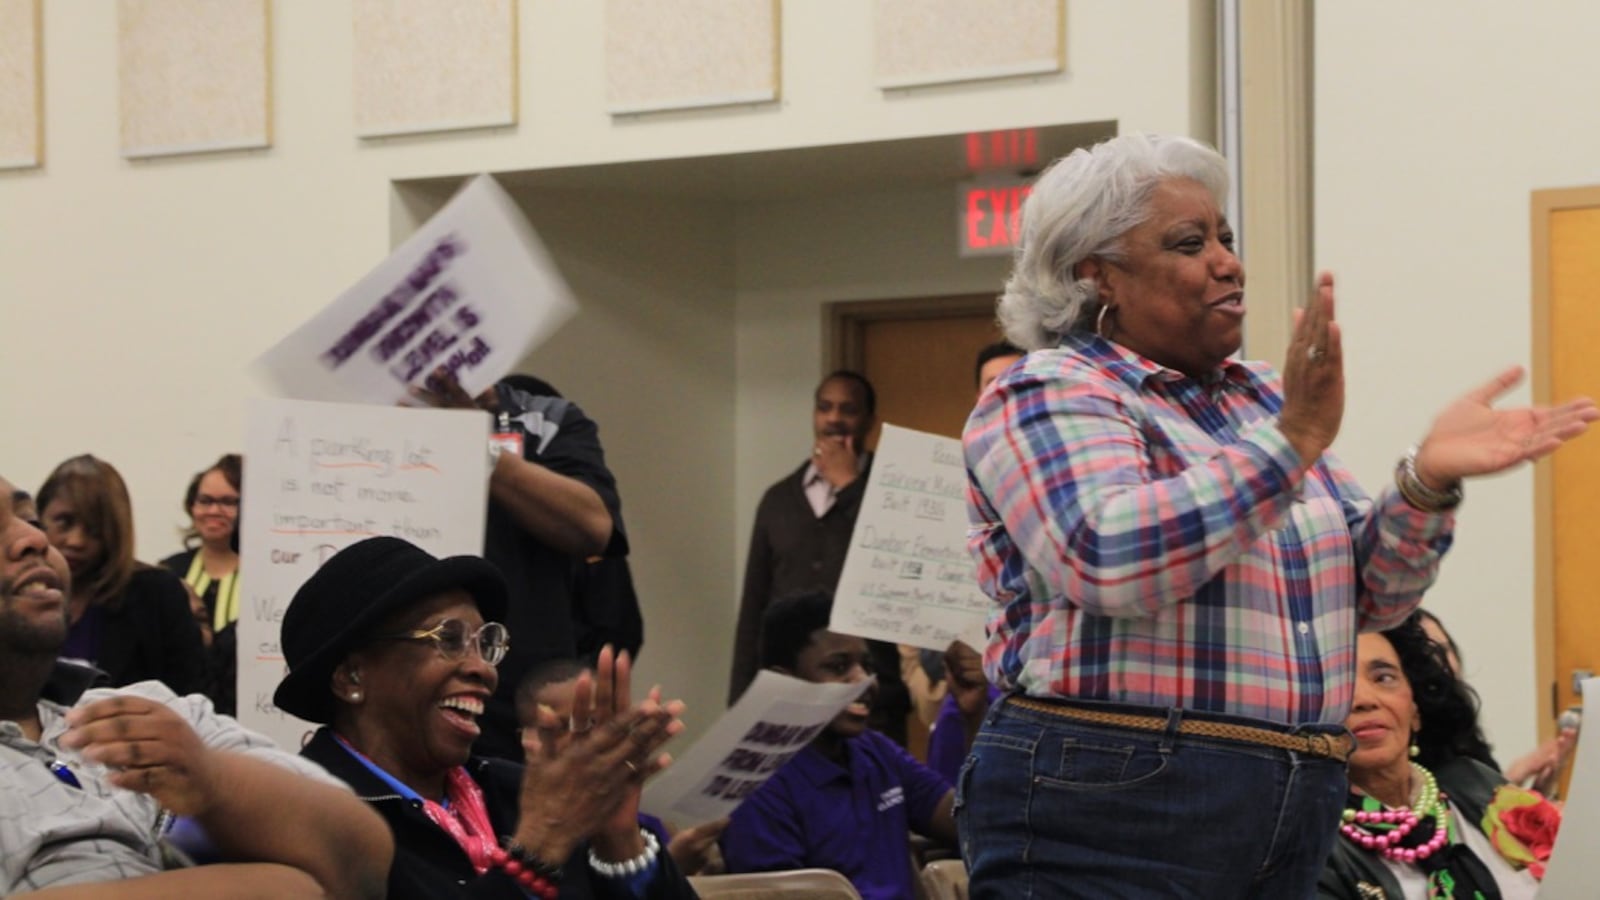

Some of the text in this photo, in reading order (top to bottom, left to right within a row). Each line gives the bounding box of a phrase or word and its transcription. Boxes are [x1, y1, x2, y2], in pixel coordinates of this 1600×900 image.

[275, 417, 433, 478] A parking lot
[281, 477, 416, 503] is not more
[272, 512, 442, 541] important than
[271, 549, 301, 565] our
